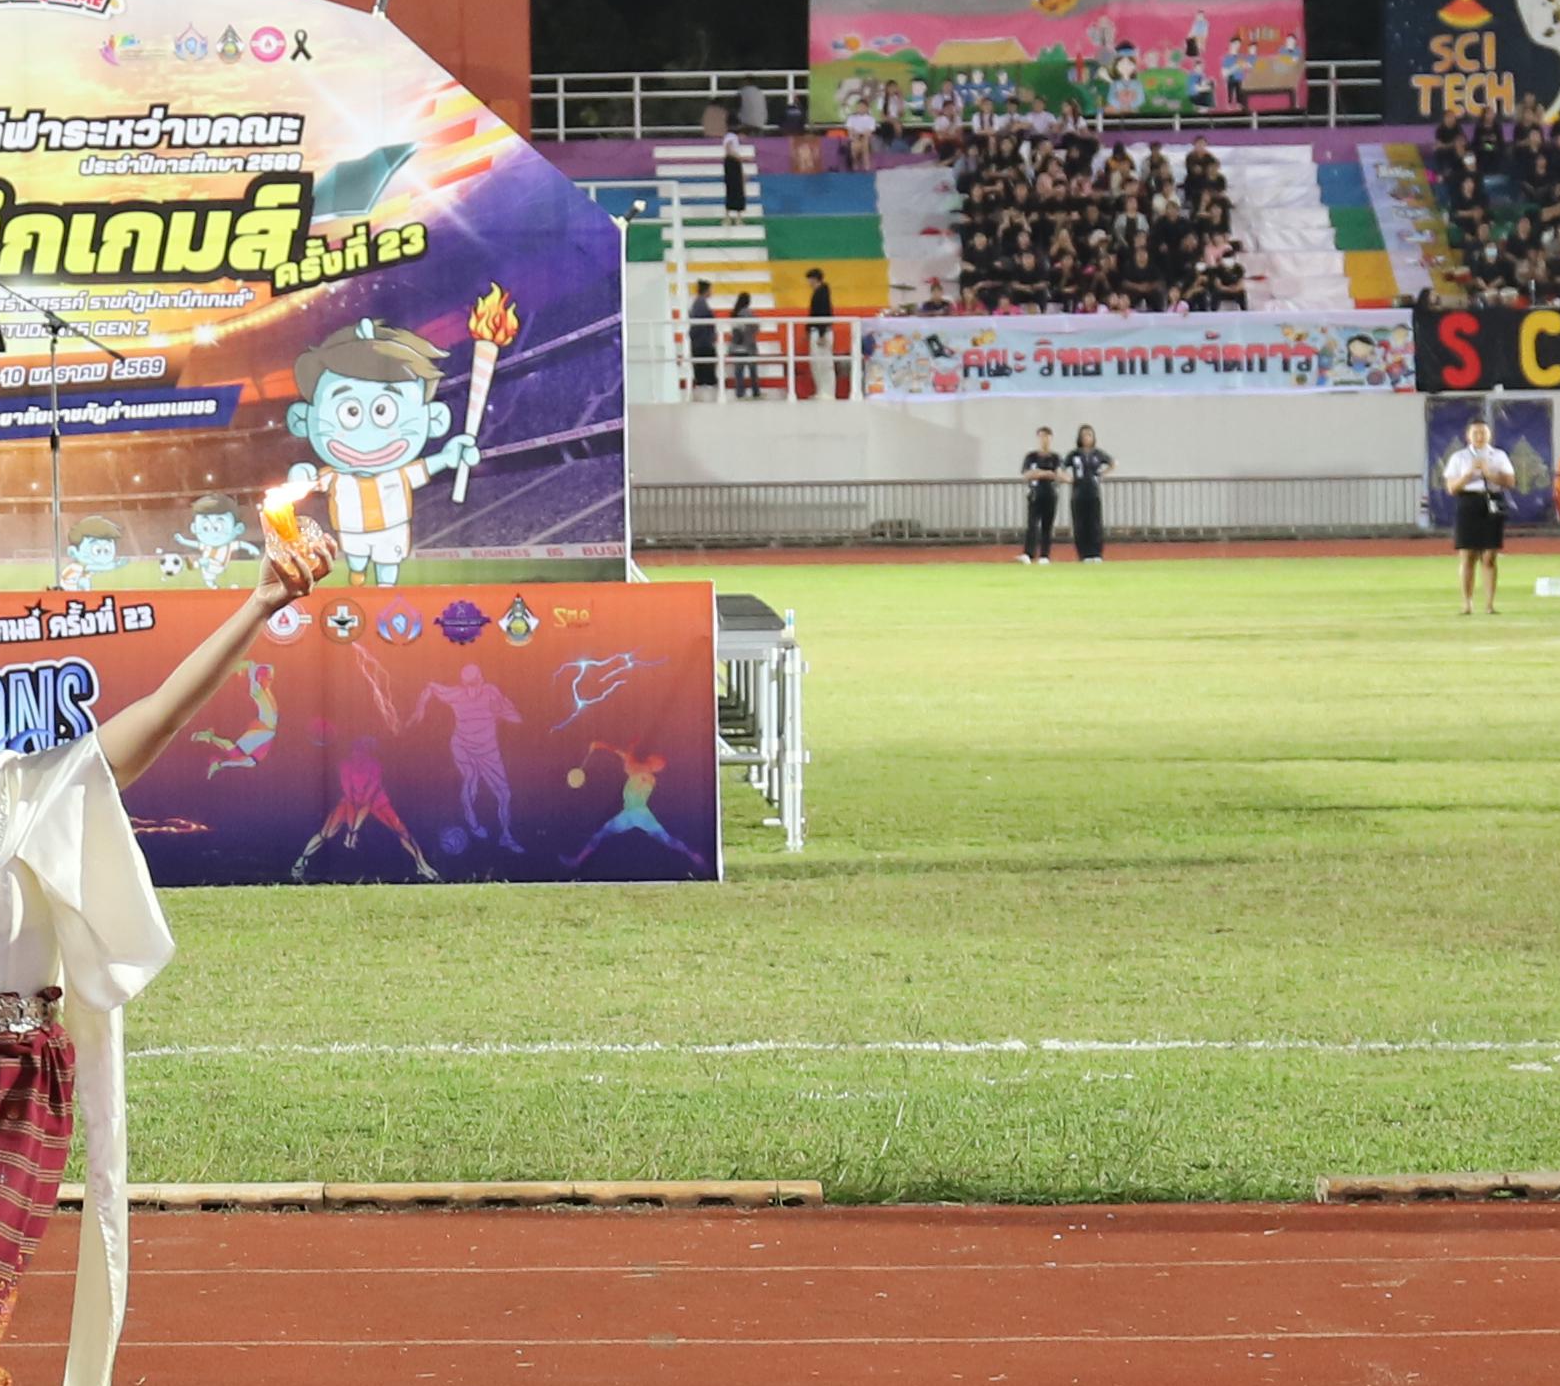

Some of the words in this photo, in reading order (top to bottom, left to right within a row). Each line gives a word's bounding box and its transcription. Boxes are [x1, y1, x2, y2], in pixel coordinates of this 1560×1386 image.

[1430, 32, 1495, 72] SCI
[1411, 71, 1515, 116] TECH
[274, 225, 368, 289] ครั้งที่
[378, 223, 425, 262] 23
[95, 321, 129, 336] GEN
[135, 321, 148, 335] Z
[31, 365, 106, 383] มกราคม
[114, 358, 166, 377] 2569
[49, 597, 116, 638] ครั้งที่
[123, 606, 154, 630] 23
